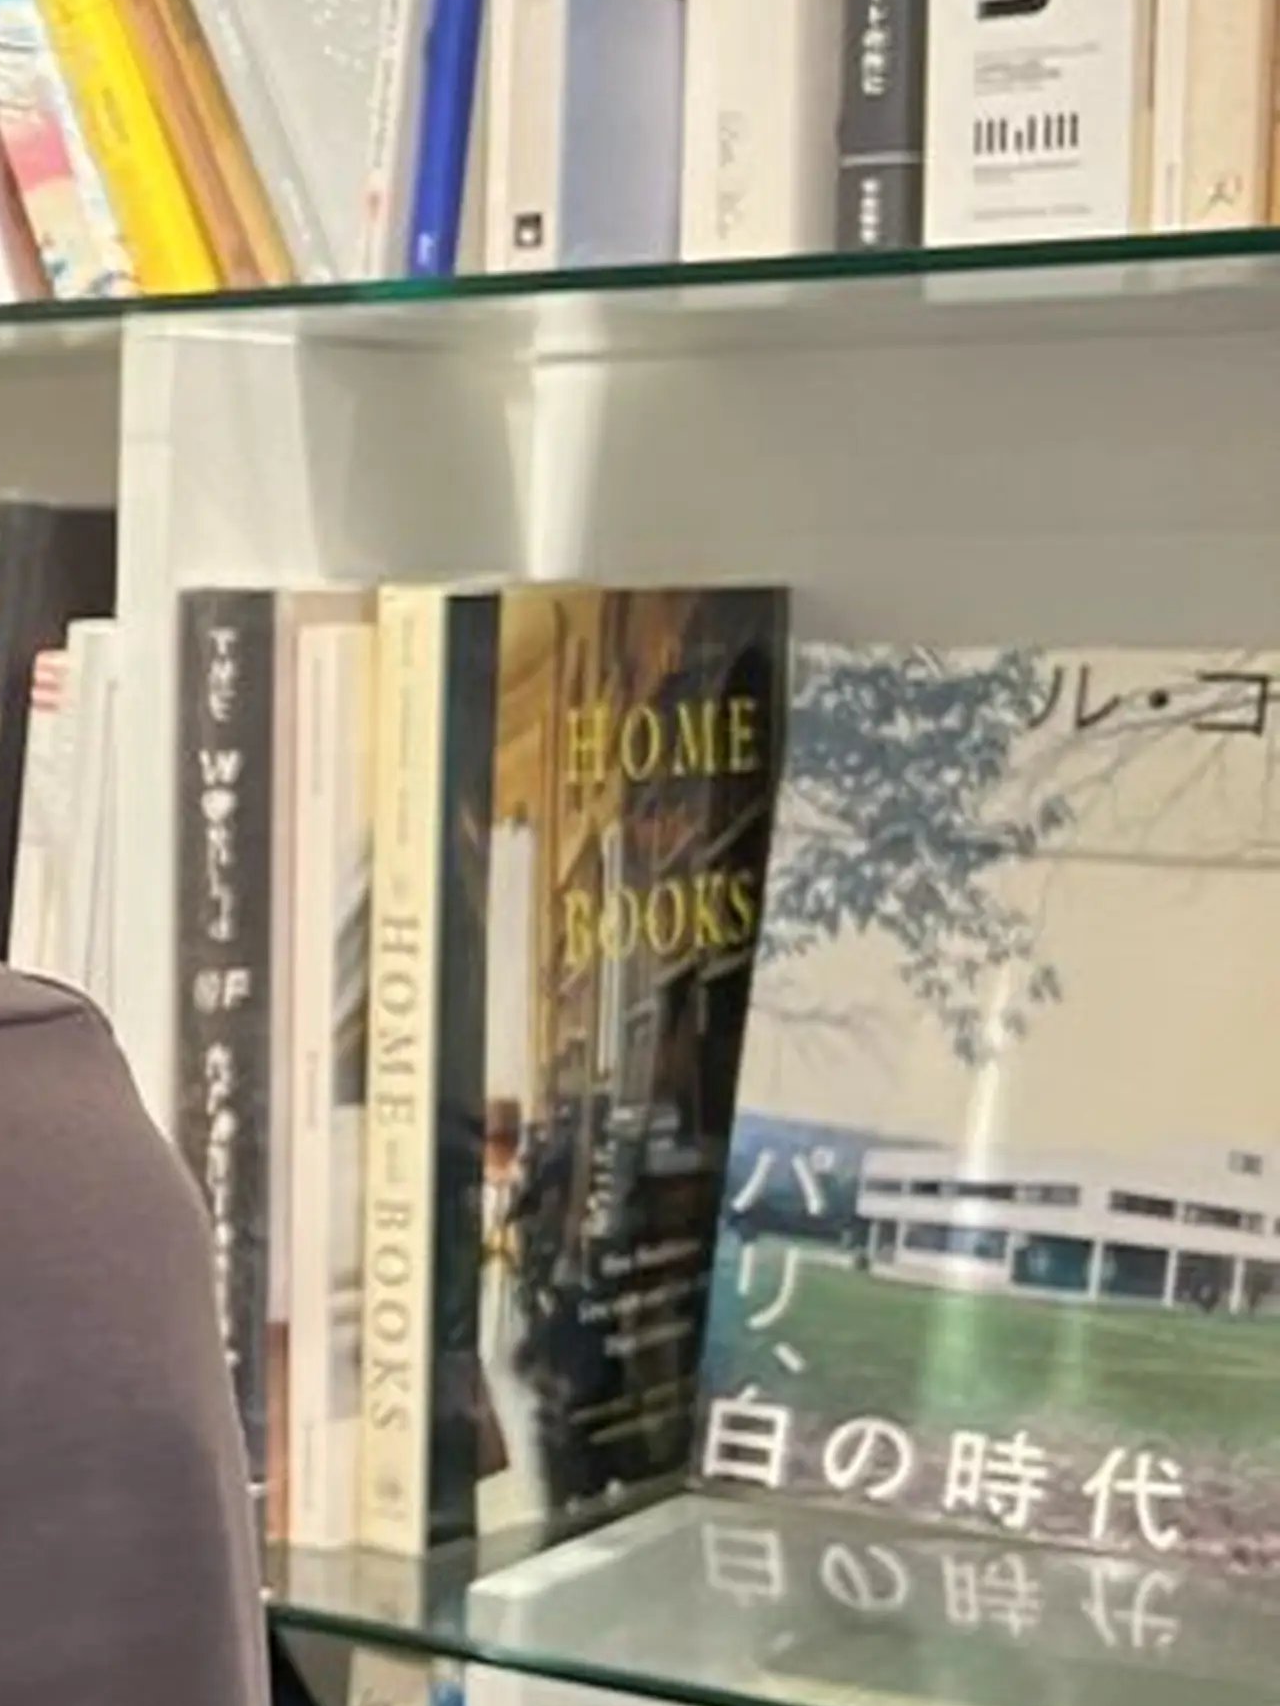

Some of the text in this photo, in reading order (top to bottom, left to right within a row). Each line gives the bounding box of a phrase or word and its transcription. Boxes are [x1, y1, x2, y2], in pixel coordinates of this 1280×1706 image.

[207, 626, 236, 722] THE
[566, 697, 757, 783] HOME
[563, 869, 756, 967] BOOKS
[370, 915, 421, 1432] HOME BOOKS
[703, 1384, 1186, 1551] 白の時代
